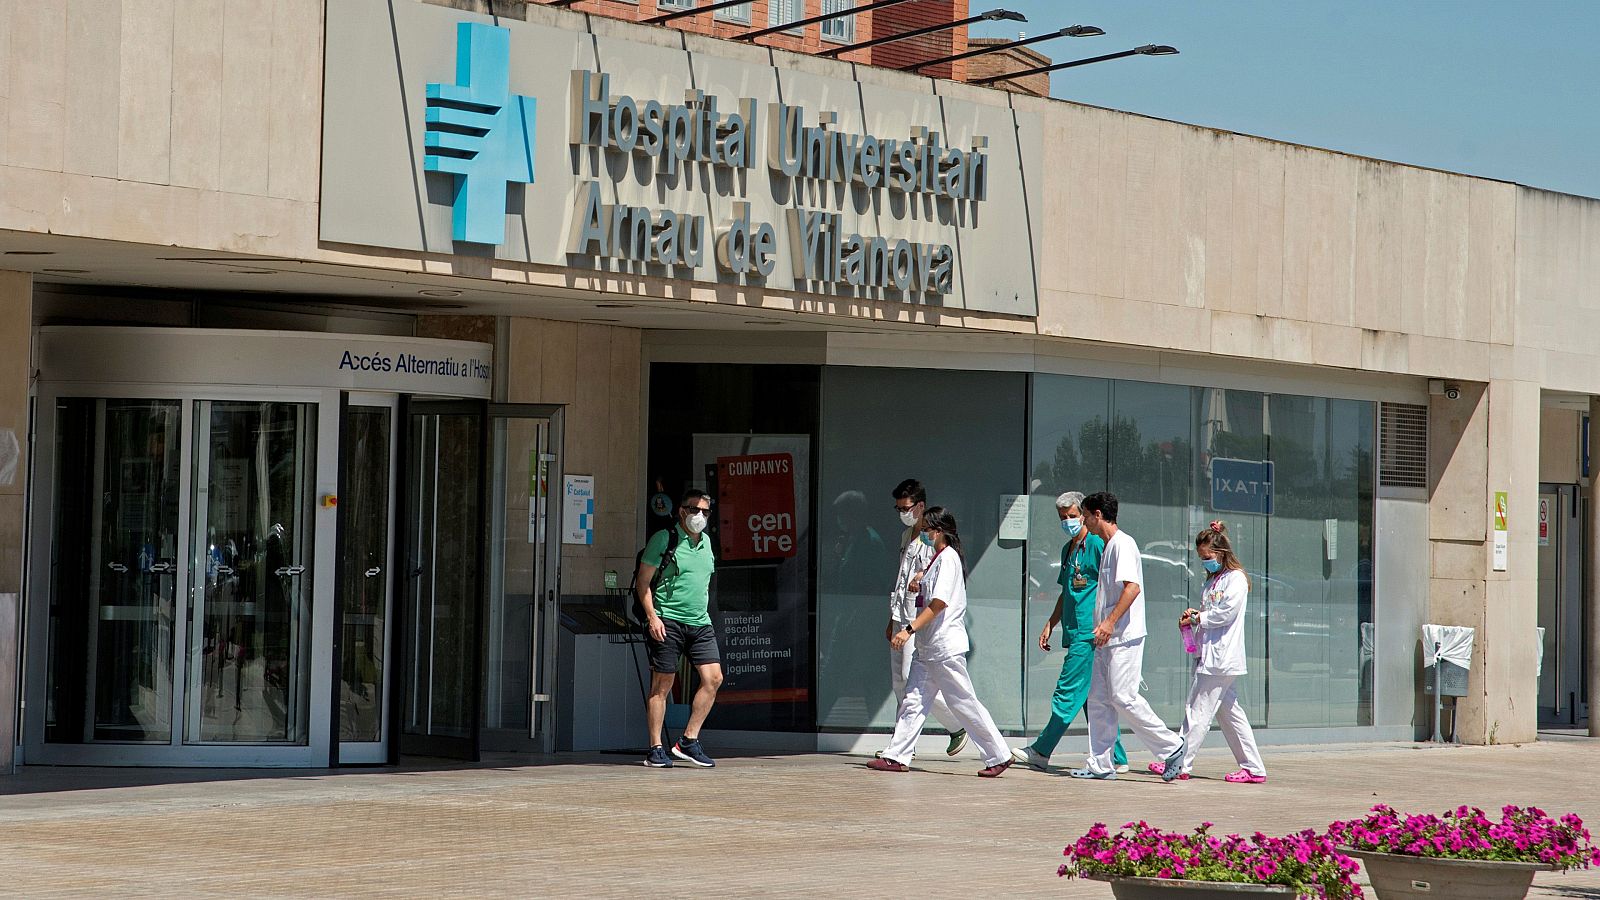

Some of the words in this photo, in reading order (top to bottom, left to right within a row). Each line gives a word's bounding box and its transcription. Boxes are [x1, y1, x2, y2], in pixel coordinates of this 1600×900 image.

[570, 70, 758, 175] Hospital
[768, 103, 988, 202] Universitari
[567, 181, 704, 269] Arnau
[718, 202, 776, 277] de
[787, 209, 953, 294] Vilanova
[339, 351, 391, 371] Accés
[395, 354, 459, 377] Alternatiu
[461, 363, 468, 377] a
[729, 460, 789, 476] COMPANYS
[747, 512, 791, 532] cen
[752, 532, 792, 553] tre
[724, 614, 762, 625] material
[725, 624, 760, 634] escolar
[725, 636, 729, 646] i
[731, 635, 771, 646] d'oficina
[726, 650, 750, 661] regal
[752, 647, 791, 659] informal
[726, 663, 767, 675] joguines
